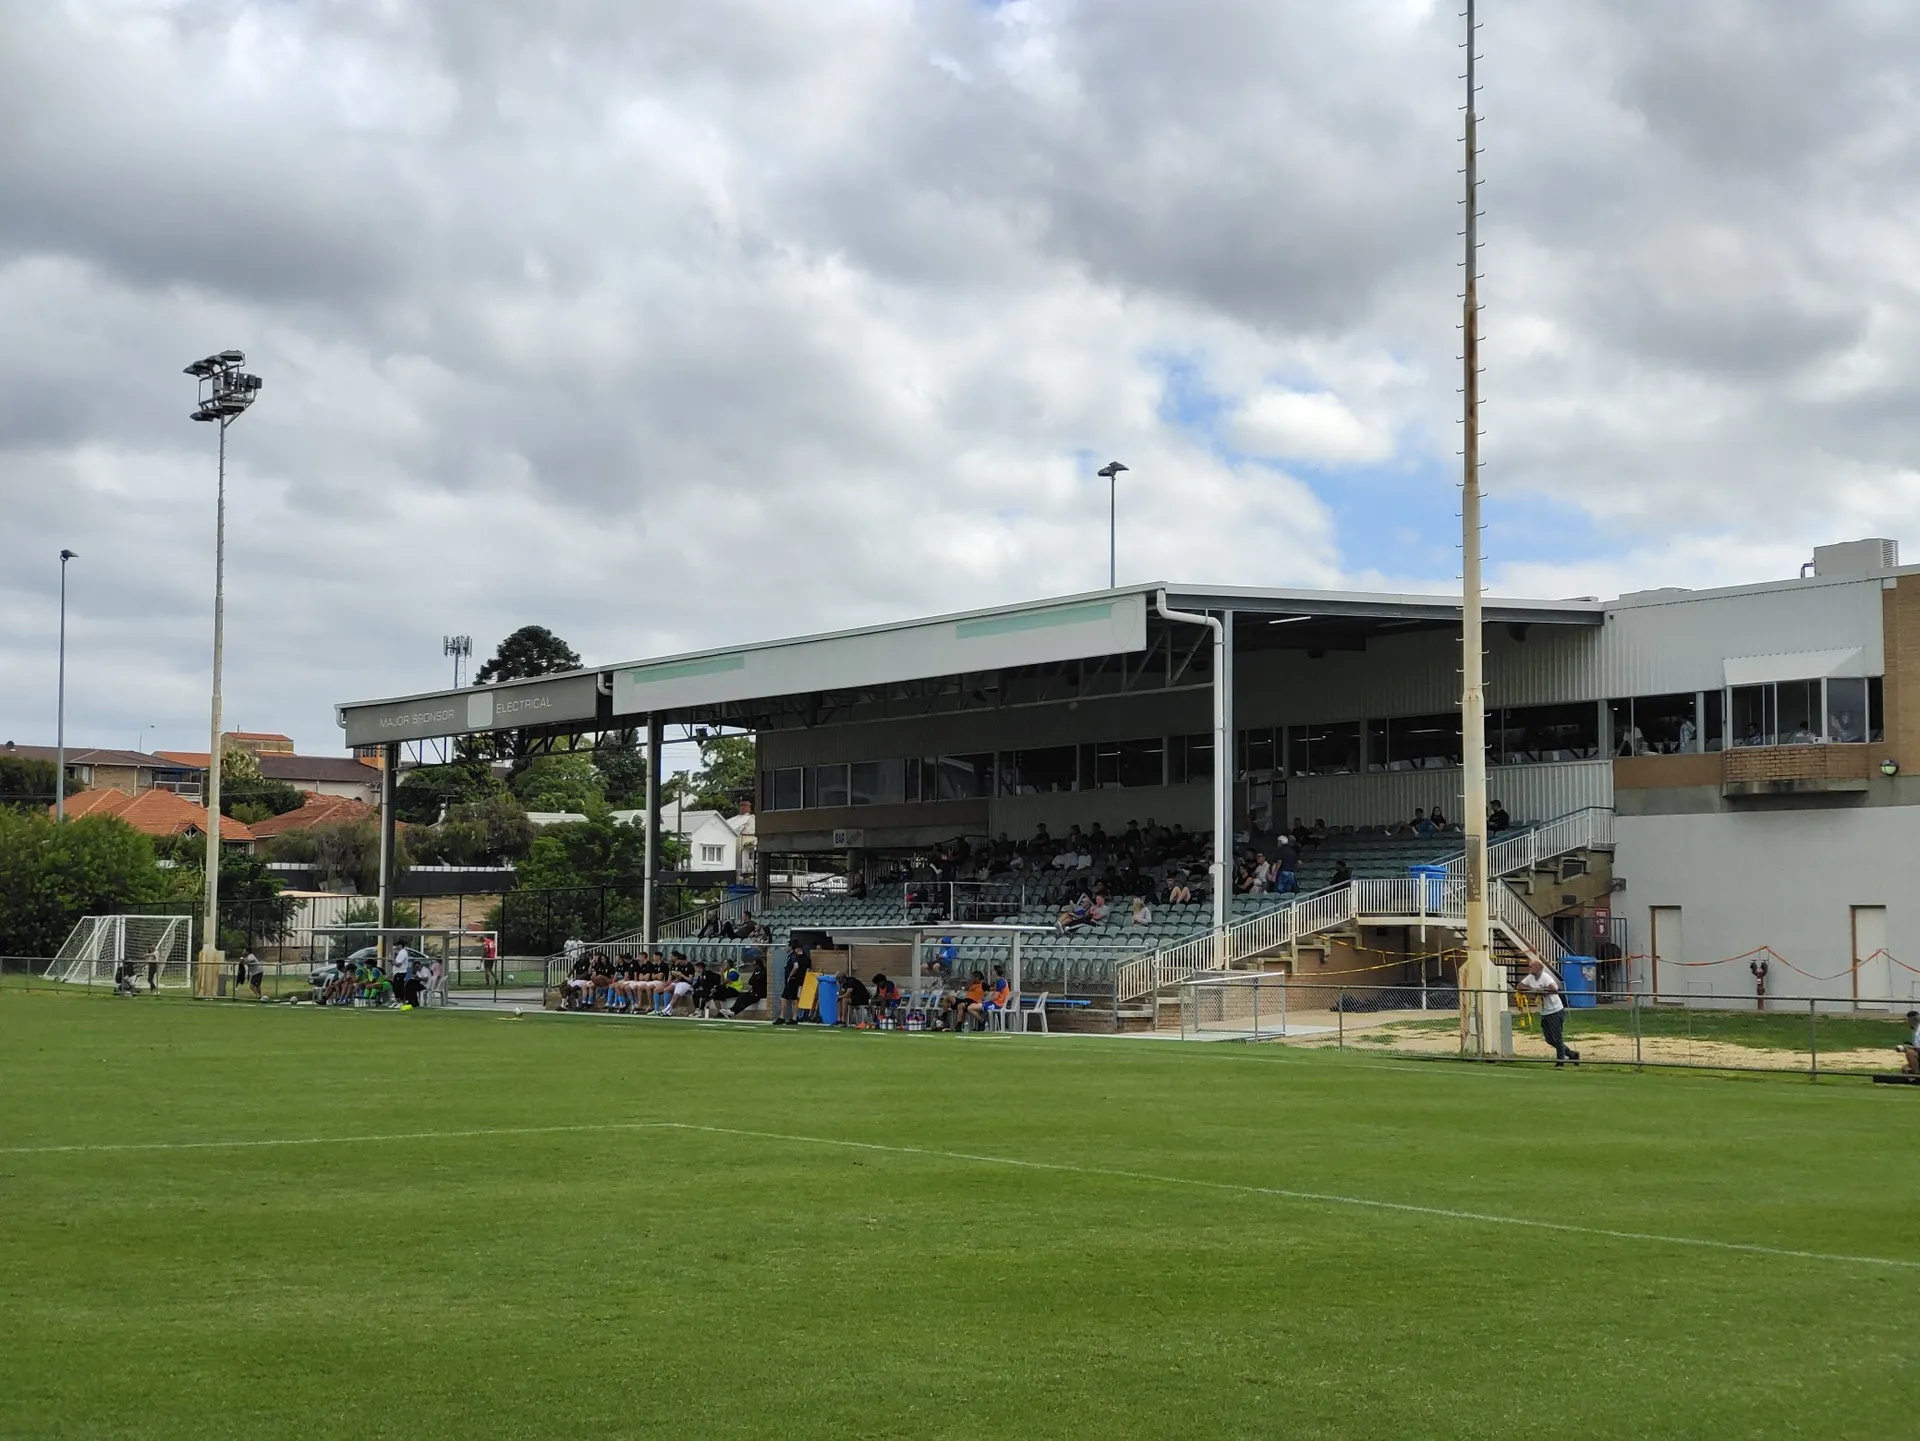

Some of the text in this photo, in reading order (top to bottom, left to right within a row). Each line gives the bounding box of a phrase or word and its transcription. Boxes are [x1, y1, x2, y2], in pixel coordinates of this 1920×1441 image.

[496, 696, 552, 714] ELECTRICAL
[380, 709, 454, 728] MAJOR SPONSOR
